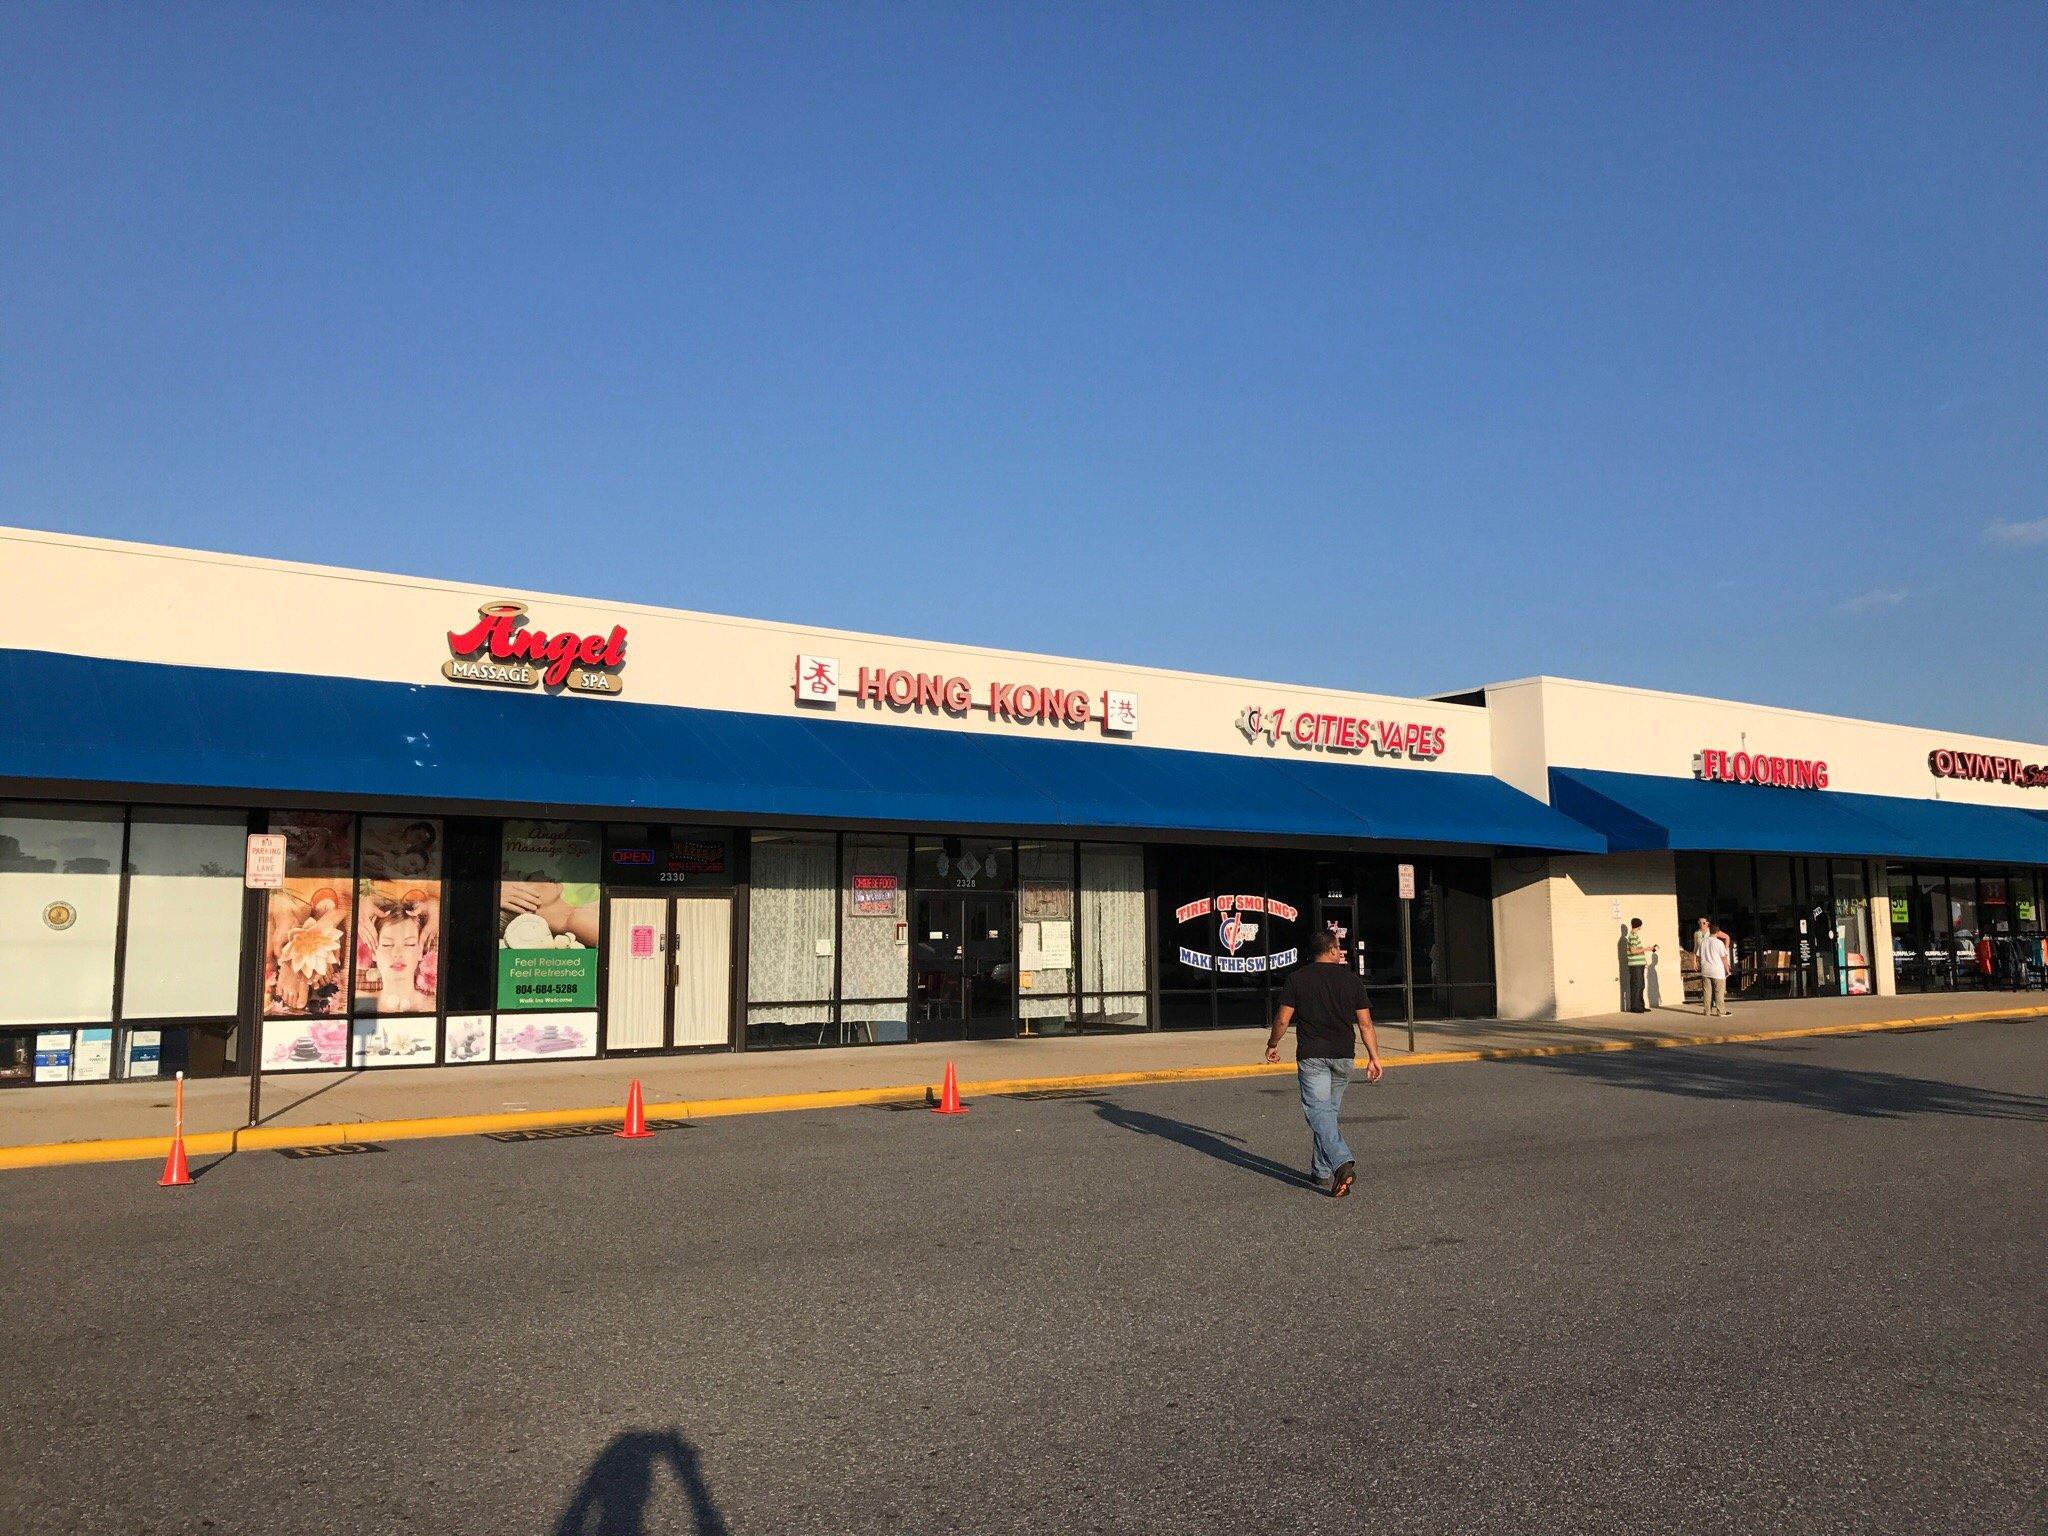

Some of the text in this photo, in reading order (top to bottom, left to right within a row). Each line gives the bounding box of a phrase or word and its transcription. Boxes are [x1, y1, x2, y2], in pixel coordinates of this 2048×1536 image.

[447, 606, 628, 686] Angel
[452, 662, 611, 689] MASSAGE SPA
[803, 658, 836, 695] 香
[859, 667, 1091, 723] HONG KONG
[1110, 699, 1136, 725] 港
[1294, 712, 1371, 749] CITIES
[1378, 719, 1446, 756] VAPES
[1702, 749, 1829, 789] FLOORING
[1935, 750, 2025, 783] OLYMPIA
[529, 827, 571, 845] Angel
[251, 847, 282, 856] PARKING
[505, 840, 563, 858] Massage
[612, 851, 652, 862] OPEN
[256, 864, 275, 872] LANE
[258, 856, 275, 864] FIRE
[660, 872, 685, 882] 2330
[956, 879, 976, 888] 2328
[1217, 895, 1235, 911] OF
[1235, 895, 1298, 922] SMOING?
[514, 957, 581, 967] Feel Relaxed
[1218, 957, 1245, 973] THE
[1246, 947, 1298, 973] SWTCH!
[509, 968, 585, 978] Feel Refreshed
[291, 1143, 368, 1156] NO
